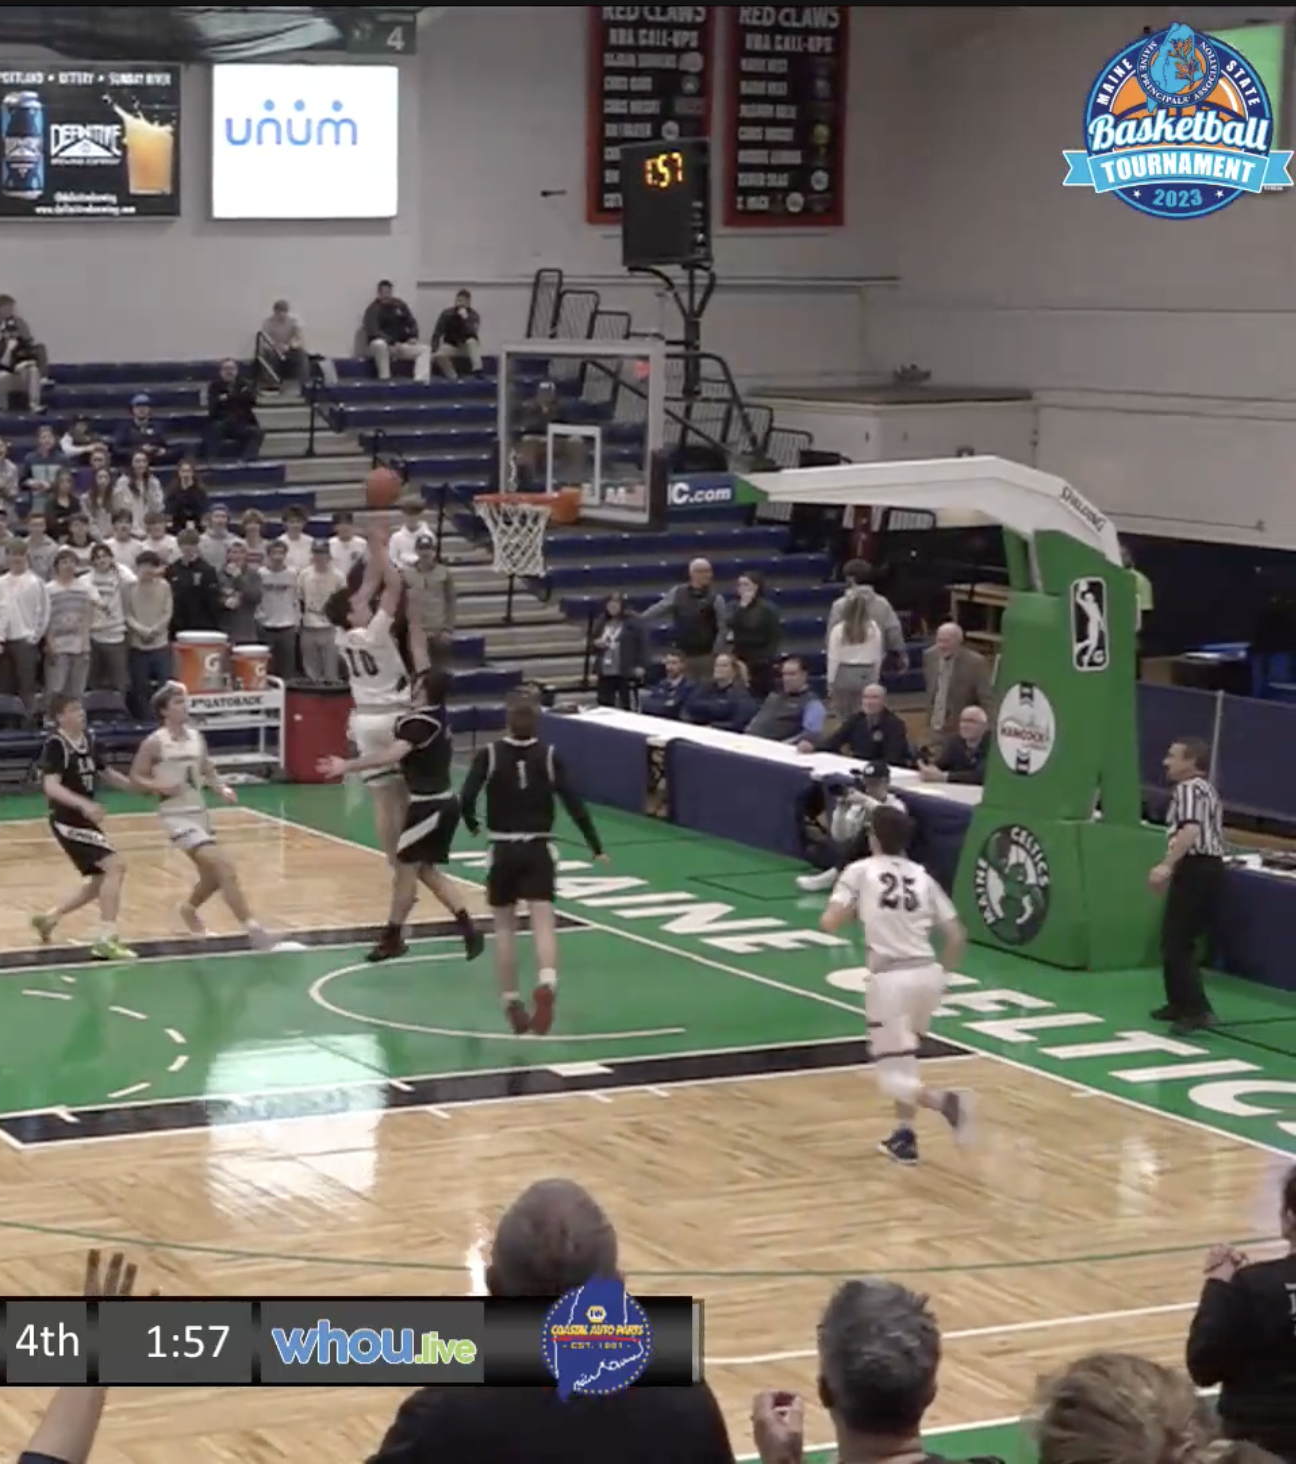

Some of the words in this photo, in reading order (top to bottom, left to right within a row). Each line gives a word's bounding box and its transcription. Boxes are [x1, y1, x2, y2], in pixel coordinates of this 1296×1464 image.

[739, 6, 775, 26] RED
[778, 6, 840, 28] CLAWS
[387, 26, 405, 50] 4
[1061, 485, 1107, 533] SPALDING
[205, 653, 221, 672] G
[345, 645, 379, 678] 10
[516, 759, 529, 790] 1
[878, 871, 922, 913] 25
